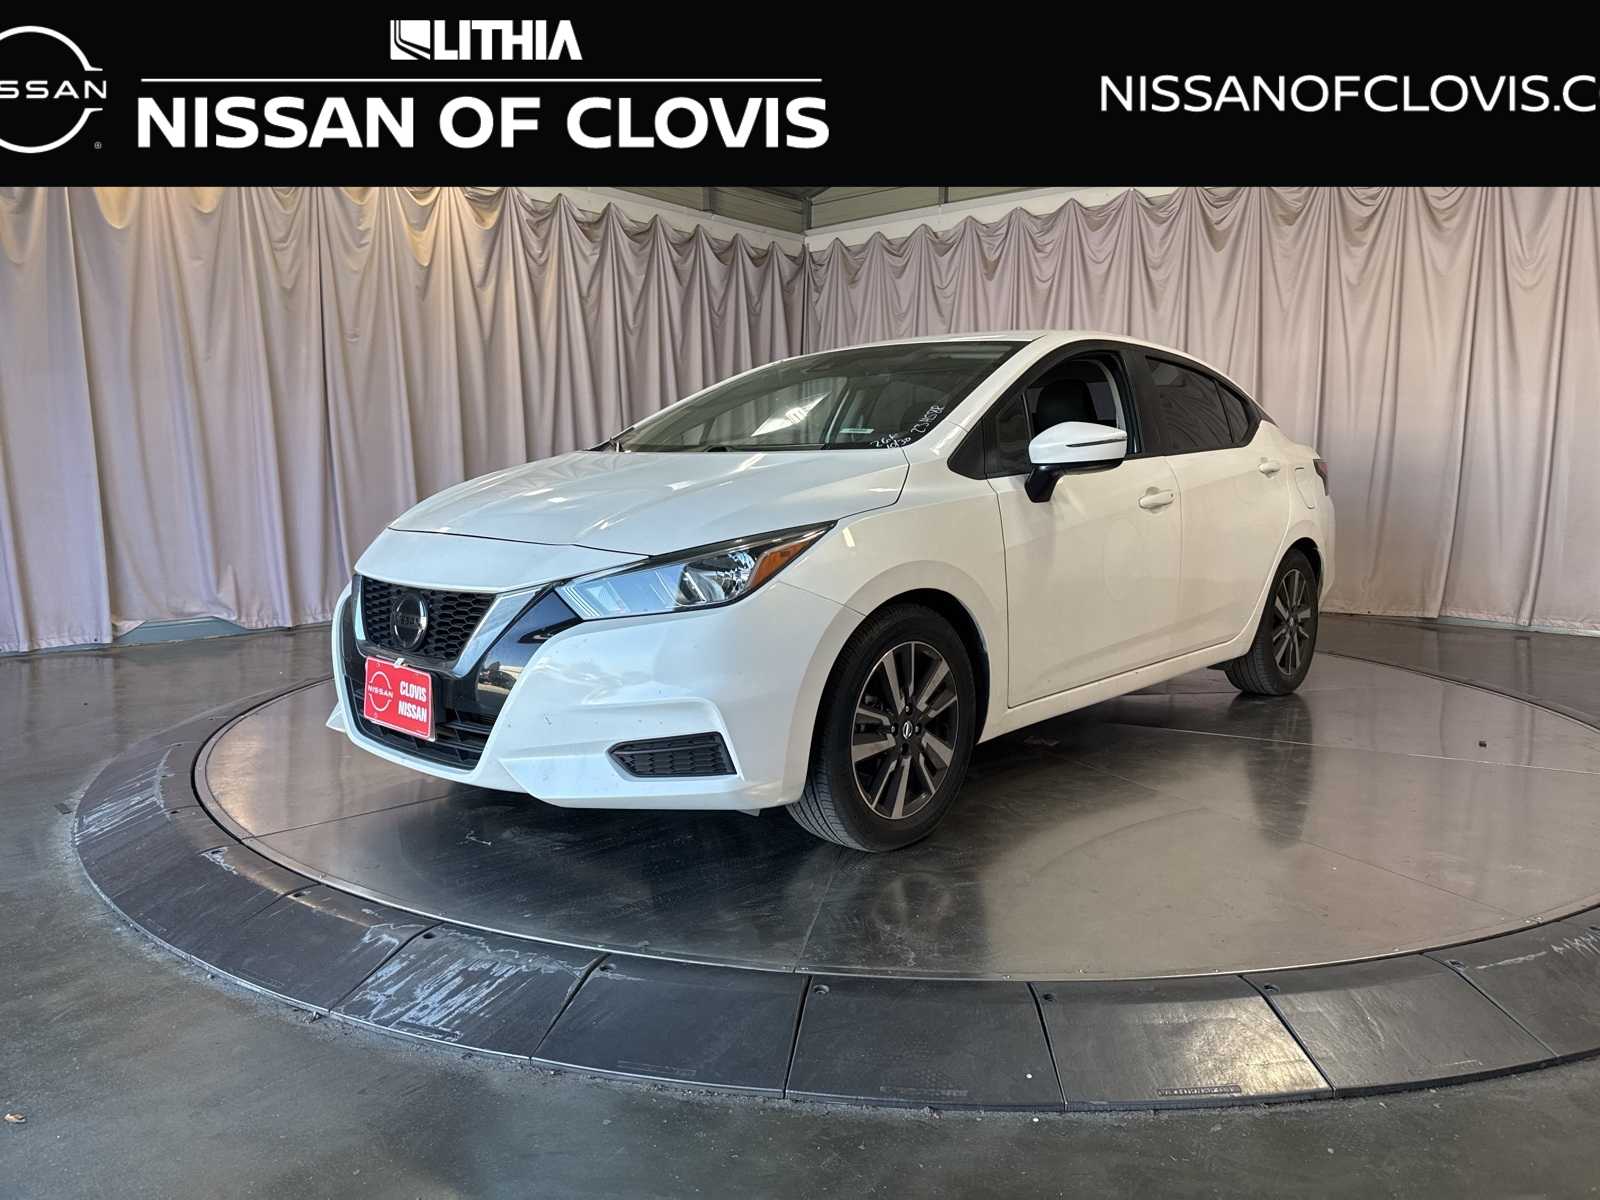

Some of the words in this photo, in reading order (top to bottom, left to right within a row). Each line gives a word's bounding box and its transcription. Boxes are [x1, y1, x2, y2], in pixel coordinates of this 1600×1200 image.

[367, 684, 393, 698] NISSAN
[399, 680, 427, 702] CLOVIS
[398, 700, 427, 722] NISSAN
